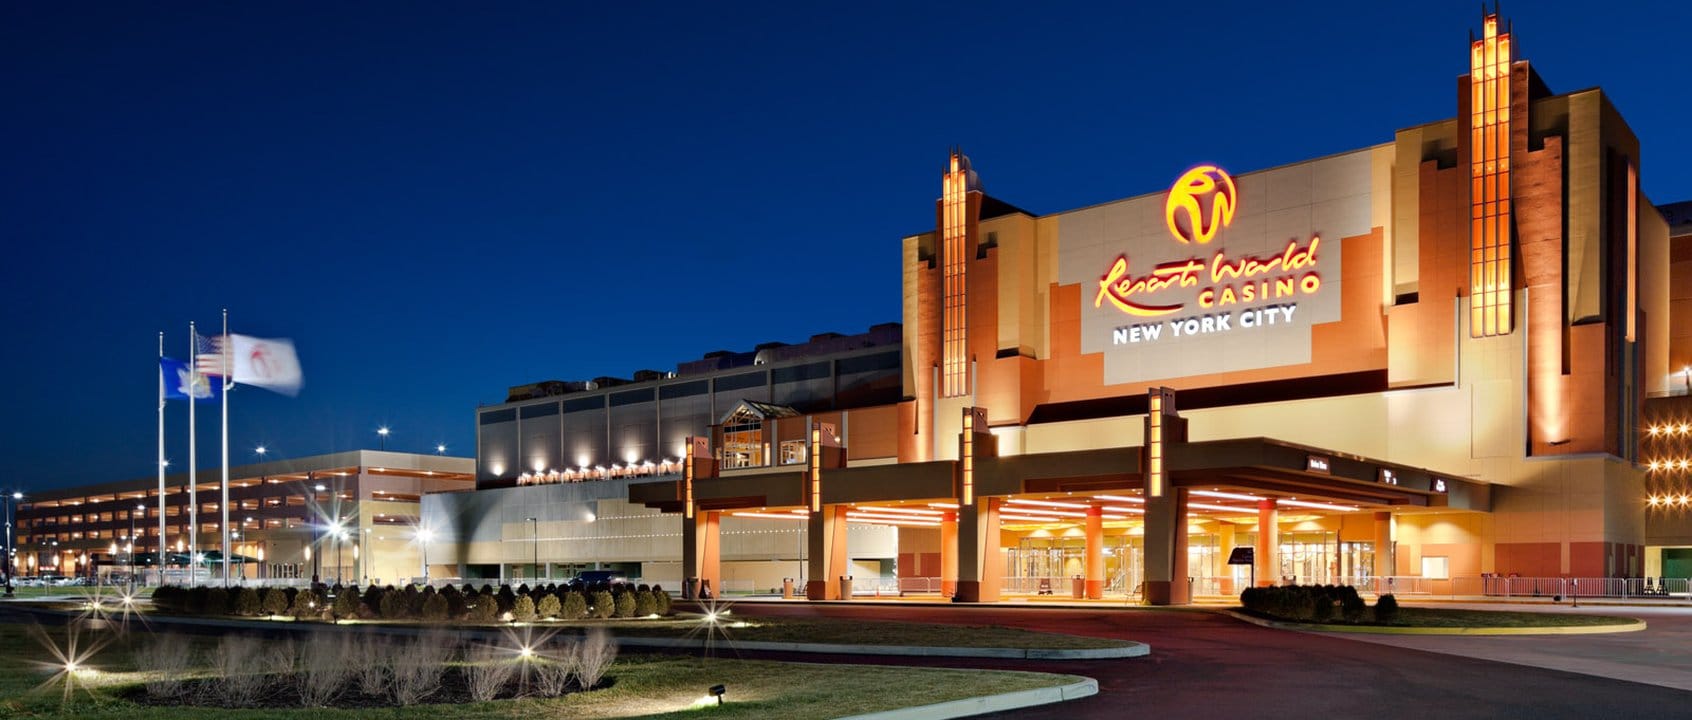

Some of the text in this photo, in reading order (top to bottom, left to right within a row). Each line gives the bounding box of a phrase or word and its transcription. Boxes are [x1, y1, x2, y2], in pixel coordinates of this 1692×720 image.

[1095, 237, 1320, 317] Resorts World
[1199, 275, 1320, 308] CASINO
[1113, 305, 1298, 345] NEW YORK CITY
